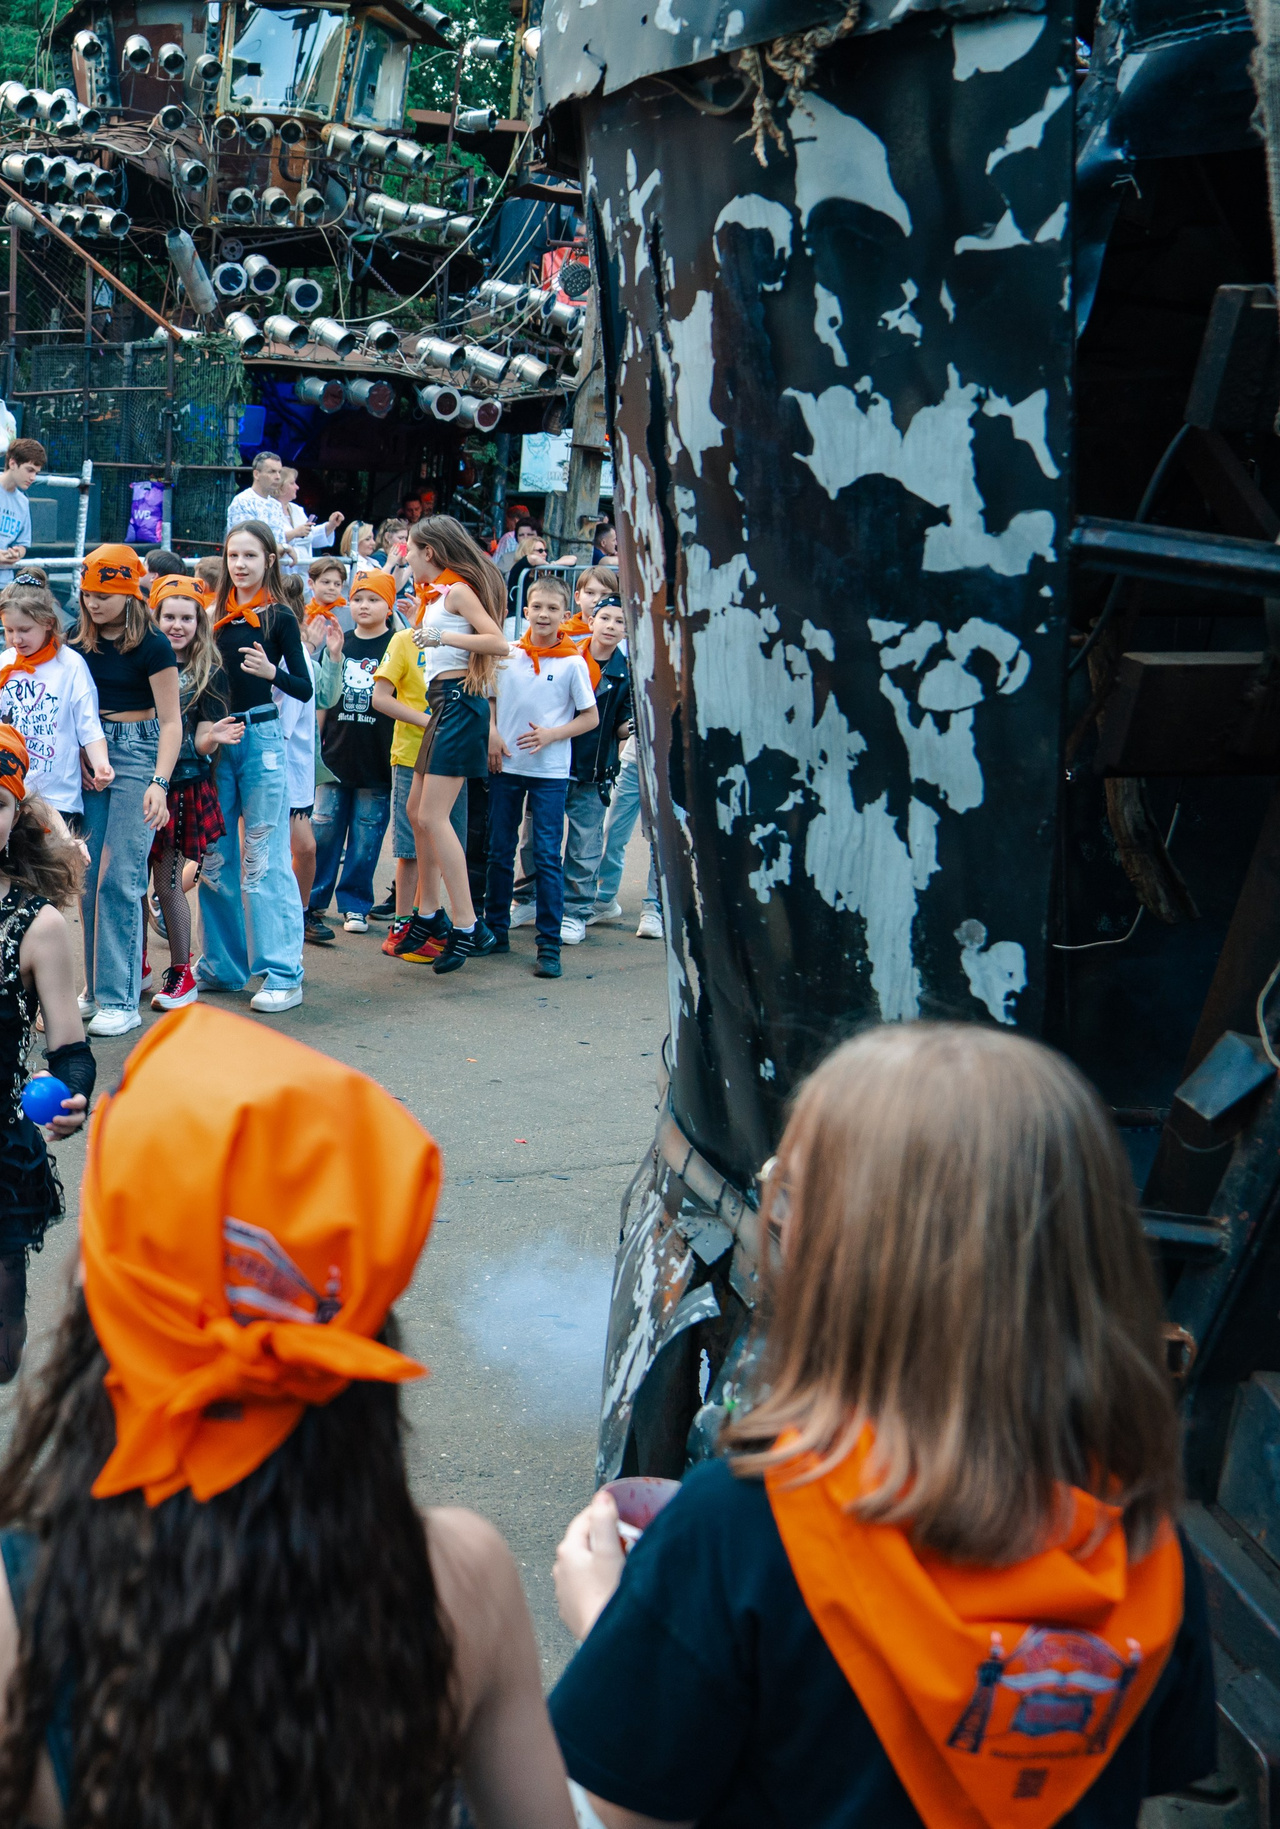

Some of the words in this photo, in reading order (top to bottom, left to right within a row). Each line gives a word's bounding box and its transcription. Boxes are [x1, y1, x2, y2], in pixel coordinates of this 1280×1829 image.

[134, 510, 151, 520] WB
[0, 515, 21, 536] IDEA
[21, 714, 47, 725] MIND
[33, 723, 54, 736] NEW
